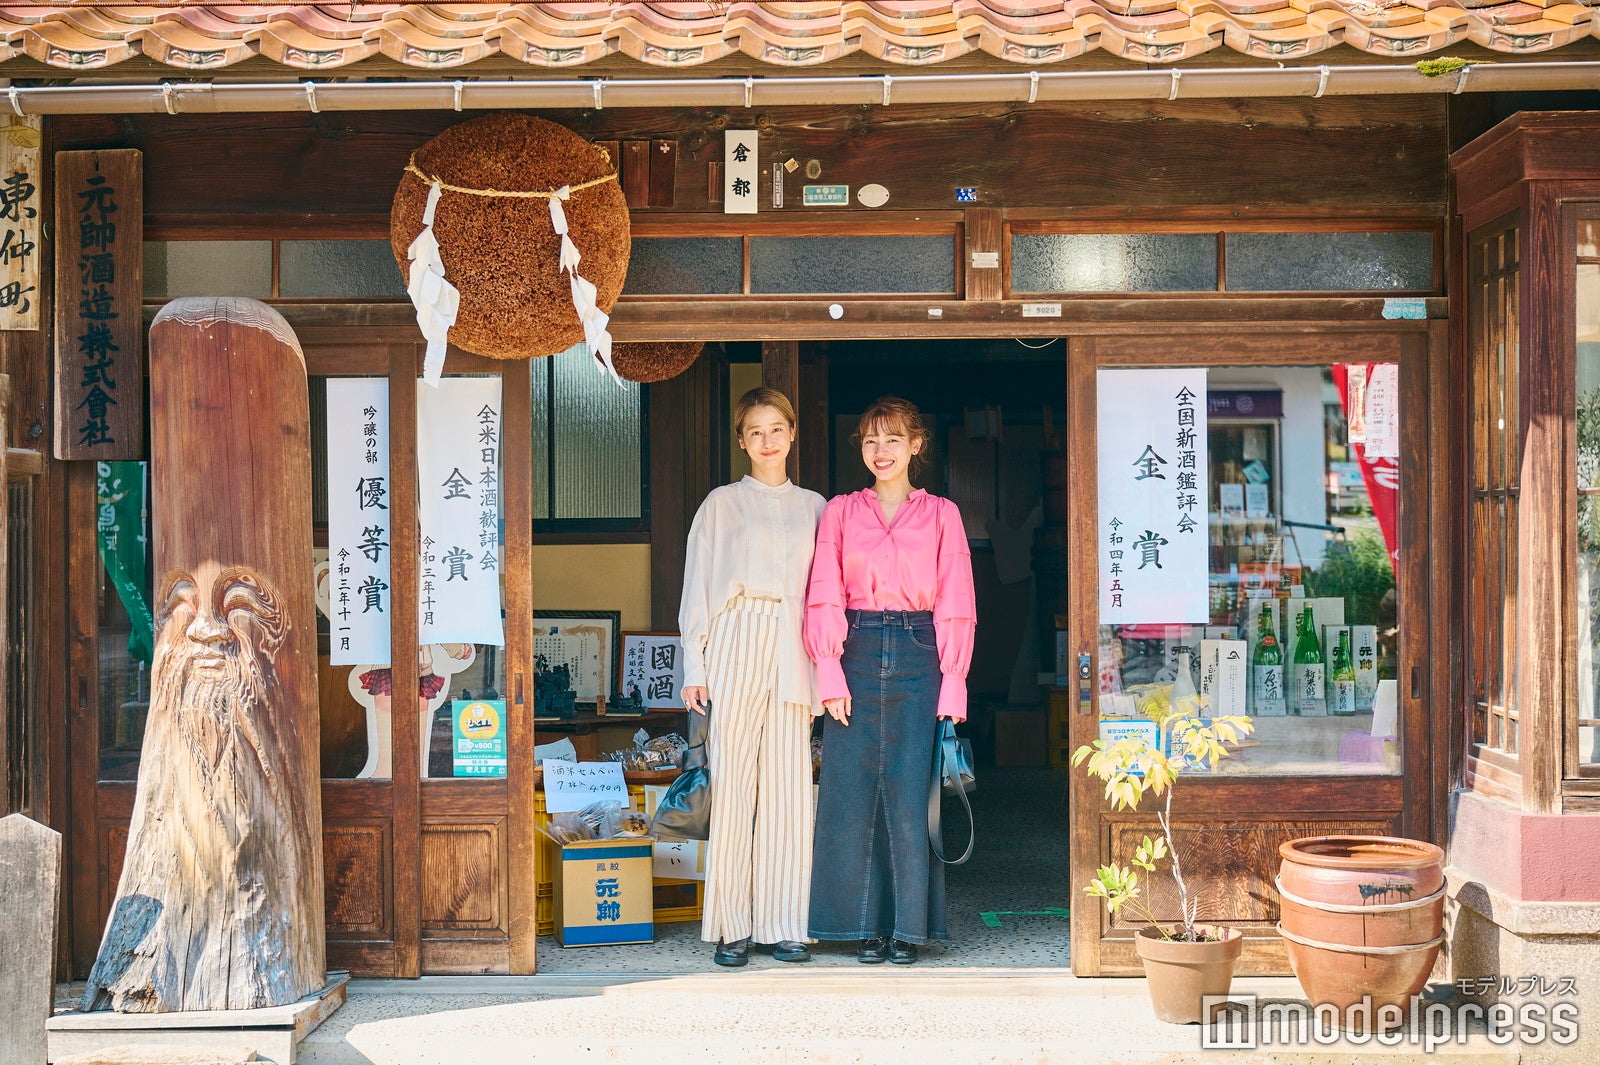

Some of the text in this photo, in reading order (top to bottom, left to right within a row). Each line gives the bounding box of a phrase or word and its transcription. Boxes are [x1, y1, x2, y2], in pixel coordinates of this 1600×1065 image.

[731, 142, 751, 198] 倉都
[0, 172, 37, 315] 東仲町
[76, 175, 120, 448] 元帥酒造株式會社
[355, 405, 389, 613] 吟醸の部 優等賞
[477, 404, 498, 571] 全米日本酒歓評会
[1132, 444, 1169, 570] 金賞
[1175, 385, 1199, 534] 全国新酒鑑評会
[422, 535, 436, 625] 令和三年十月
[441, 467, 473, 582] 金賞
[1108, 516, 1124, 608] 令和四年五月
[337, 548, 352, 651] 令和三年十一月
[595, 878, 621, 922] 元帥
